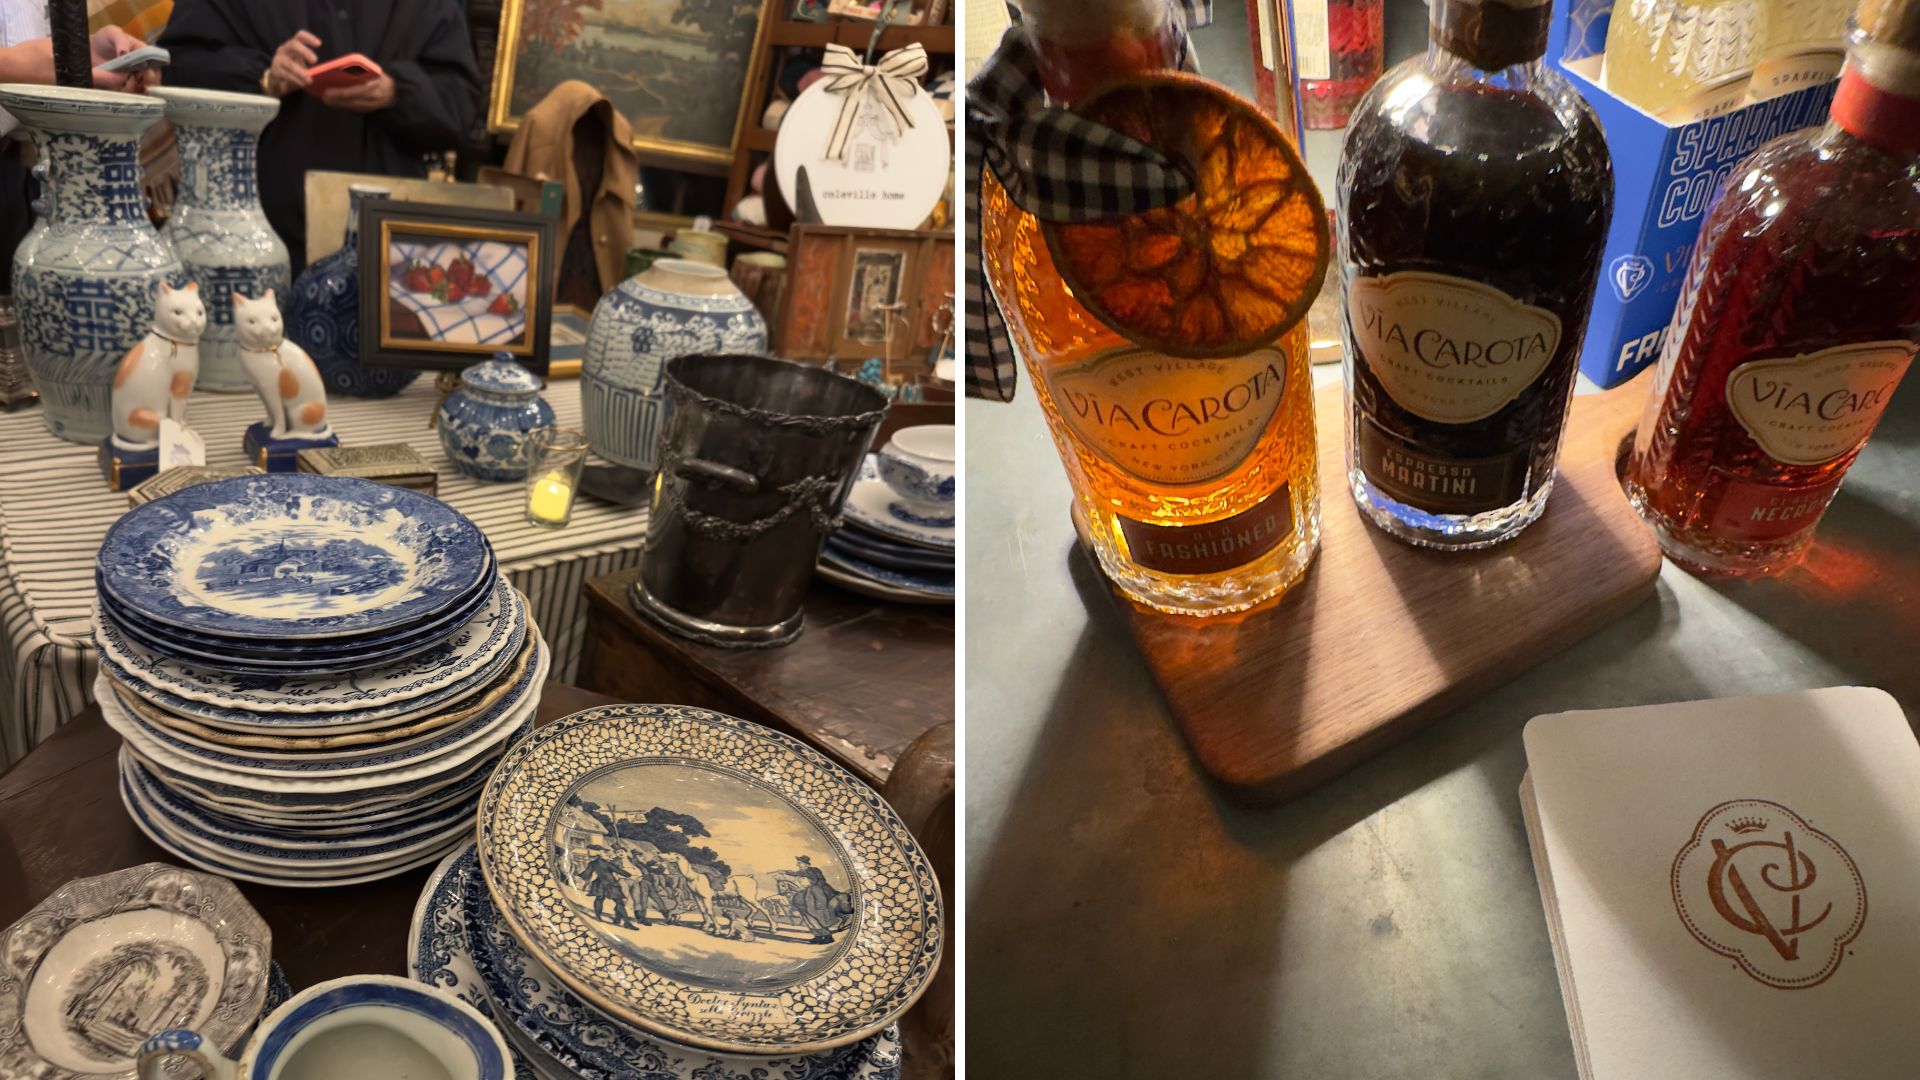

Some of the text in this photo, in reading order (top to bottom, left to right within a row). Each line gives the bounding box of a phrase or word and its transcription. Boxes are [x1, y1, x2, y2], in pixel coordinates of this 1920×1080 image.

[882, 187, 905, 200] home
[1413, 327, 1547, 369] CAROTA
[1426, 372, 1508, 386] COCKTAILS
[1141, 363, 1282, 437] CAROTA
[1107, 417, 1255, 451] CRAFT COCKTAILS
[1131, 455, 1163, 472] NEW
[1170, 457, 1209, 472] YORK
[1381, 456, 1477, 495] MARTINI
[1386, 448, 1472, 477] ESPRESSO
[1144, 514, 1277, 561] FASHIONED
[1192, 526, 1231, 542] OLD
